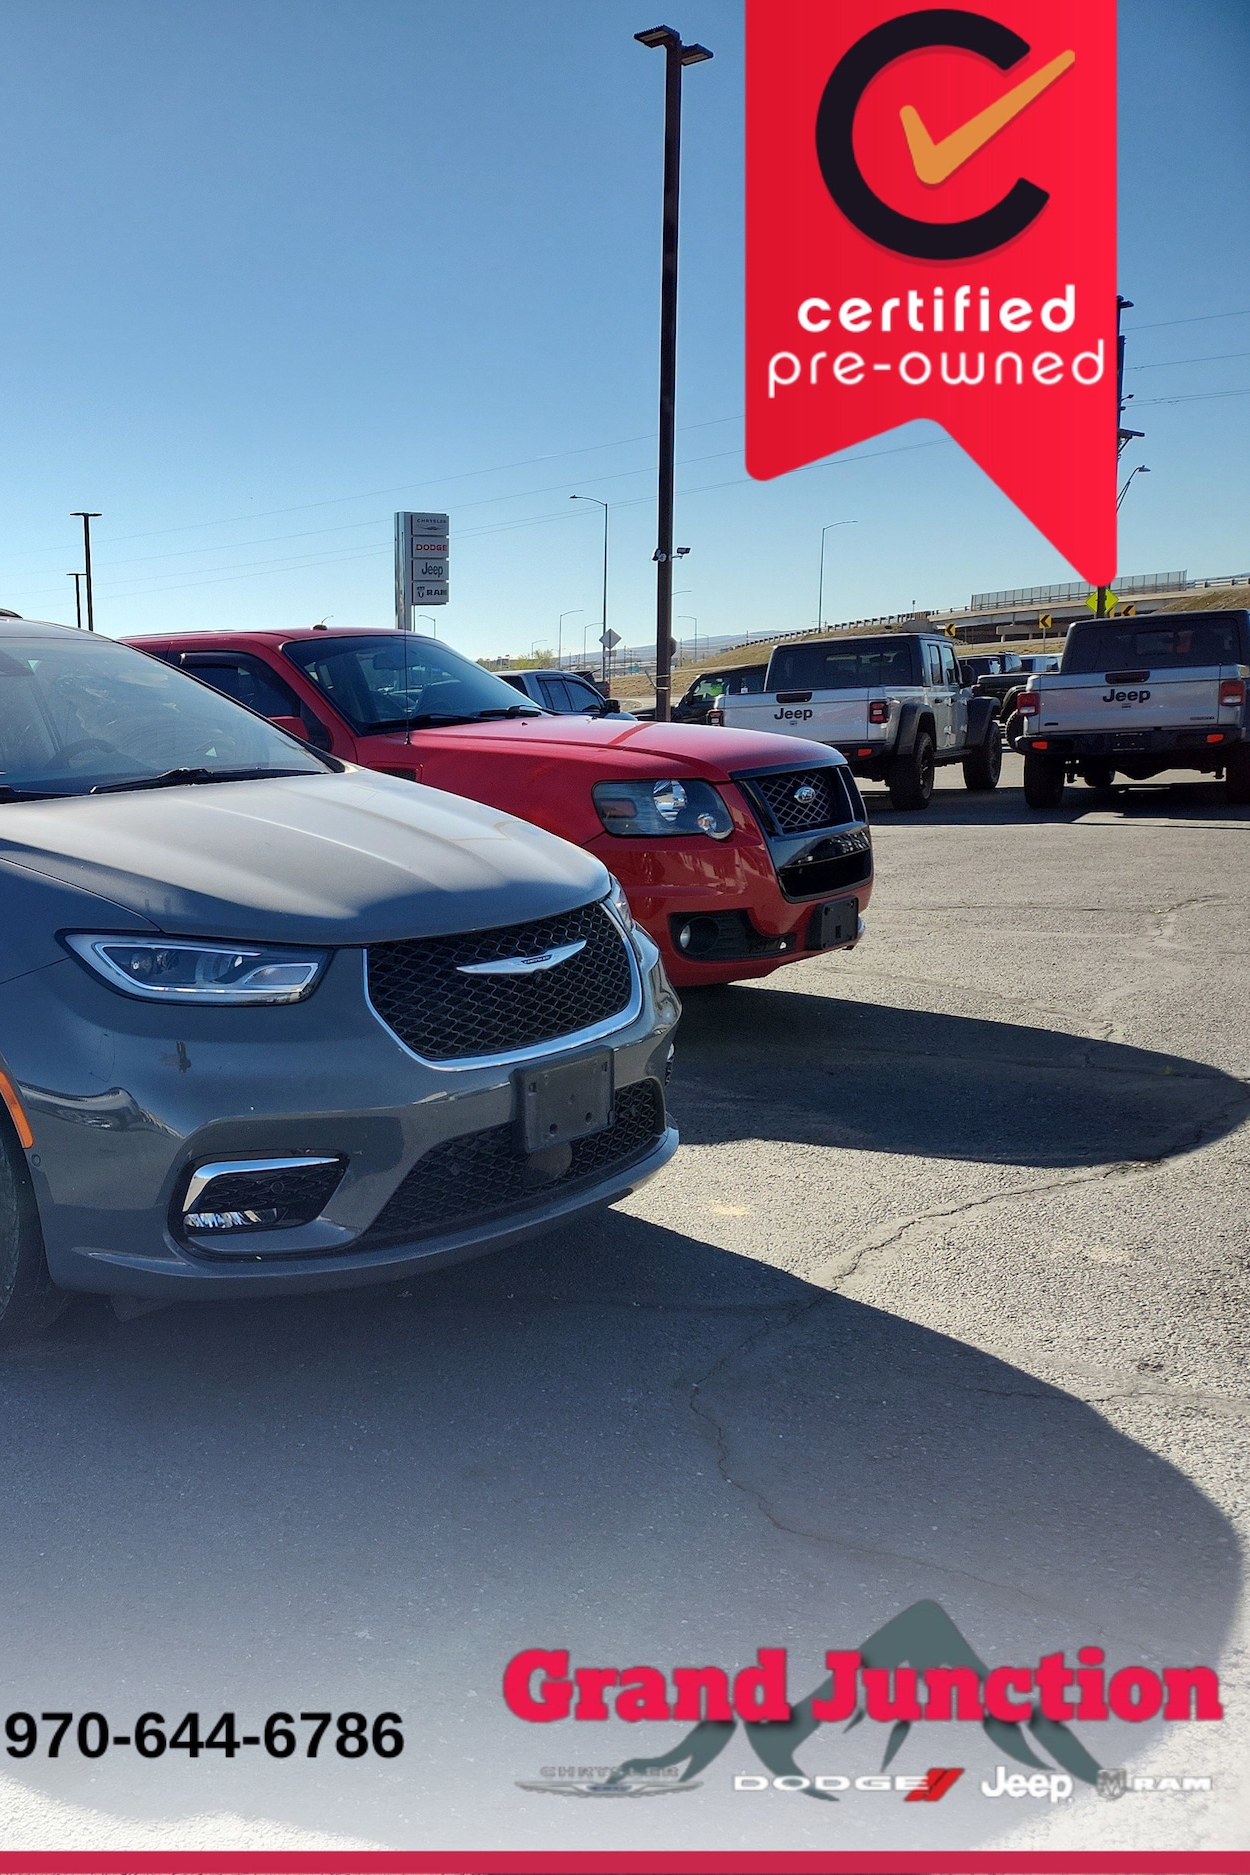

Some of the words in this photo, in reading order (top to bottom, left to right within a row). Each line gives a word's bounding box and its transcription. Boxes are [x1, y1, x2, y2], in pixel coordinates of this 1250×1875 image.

[421, 562, 443, 577] Jeep
[1102, 688, 1151, 703] Jeep
[774, 707, 813, 721] Jeep
